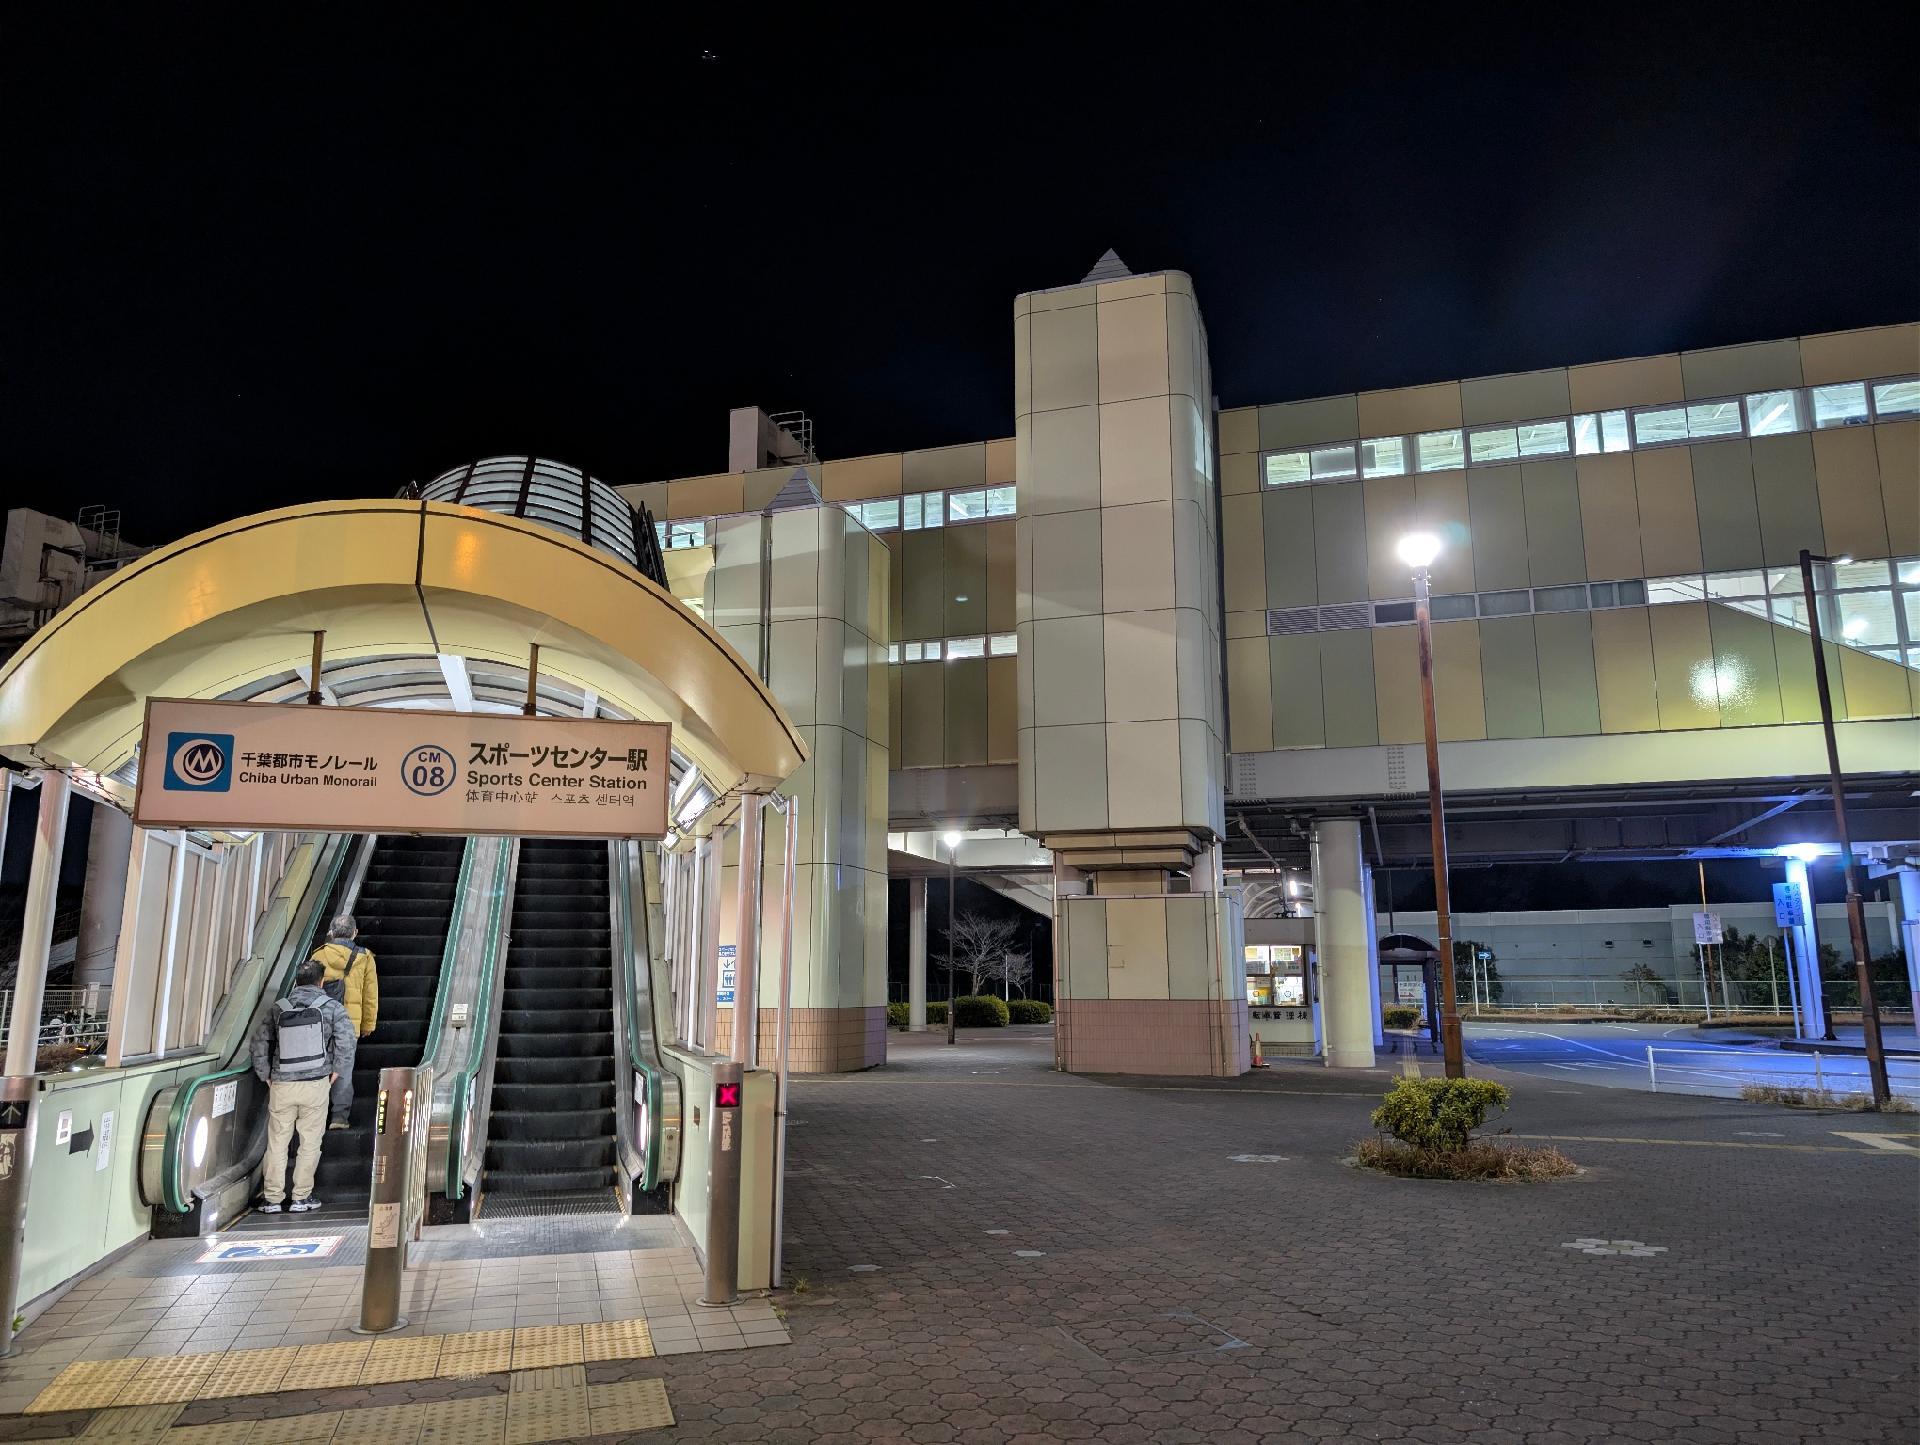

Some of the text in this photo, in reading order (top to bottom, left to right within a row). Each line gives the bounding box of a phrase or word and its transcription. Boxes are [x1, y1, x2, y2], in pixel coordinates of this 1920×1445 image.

[240, 752, 378, 771] 千葉都市モノレール
[418, 752, 441, 763] CM
[468, 742, 648, 772] スポーツセンター駅
[239, 772, 378, 787] Chiba Urban Monorail
[412, 765, 445, 787] 08
[467, 770, 648, 790] Sports Center Station
[465, 789, 539, 804] 体育中心站
[551, 793, 635, 807] 스포츠 센터역
